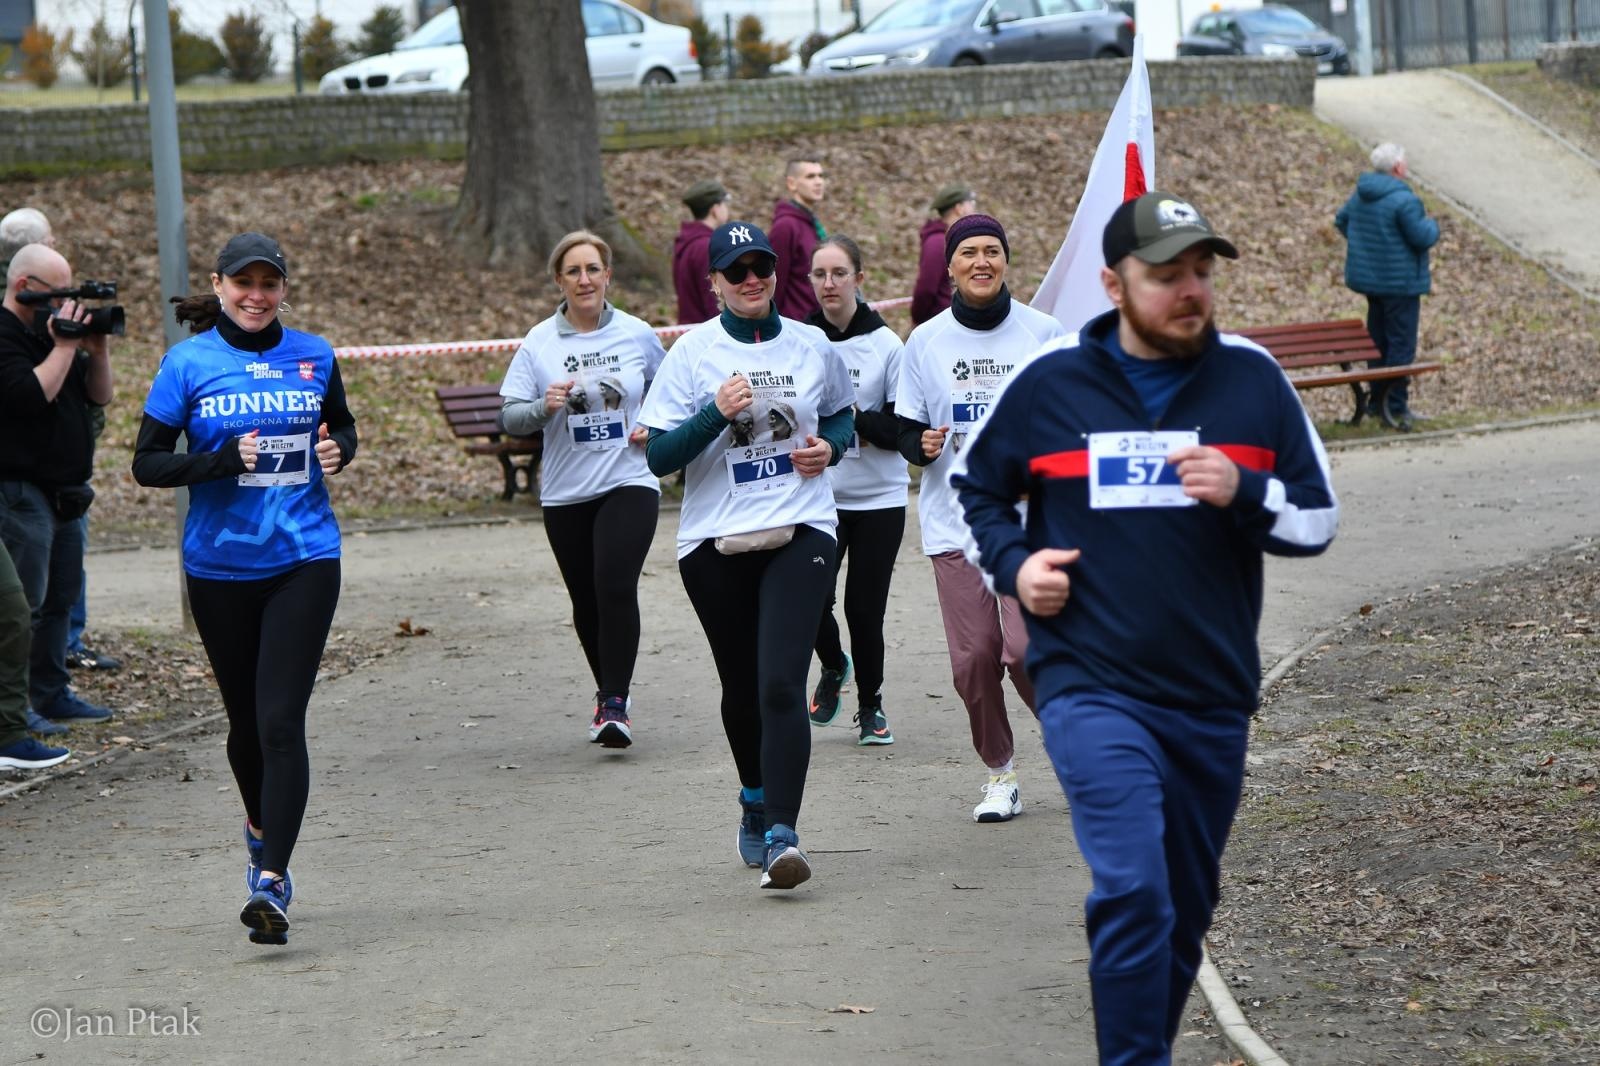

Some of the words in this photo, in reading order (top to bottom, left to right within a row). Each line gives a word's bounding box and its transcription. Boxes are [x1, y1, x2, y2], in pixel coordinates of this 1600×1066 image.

[729, 226, 753, 245] NY
[582, 355, 619, 367] WILCZYM
[751, 376, 794, 386] WILCZYM
[286, 416, 313, 424] TEAM
[590, 425, 610, 440] 55
[271, 442, 294, 450] WILCZYM
[272, 453, 285, 472] 7
[752, 458, 777, 479] 70
[1127, 457, 1166, 484] 57
